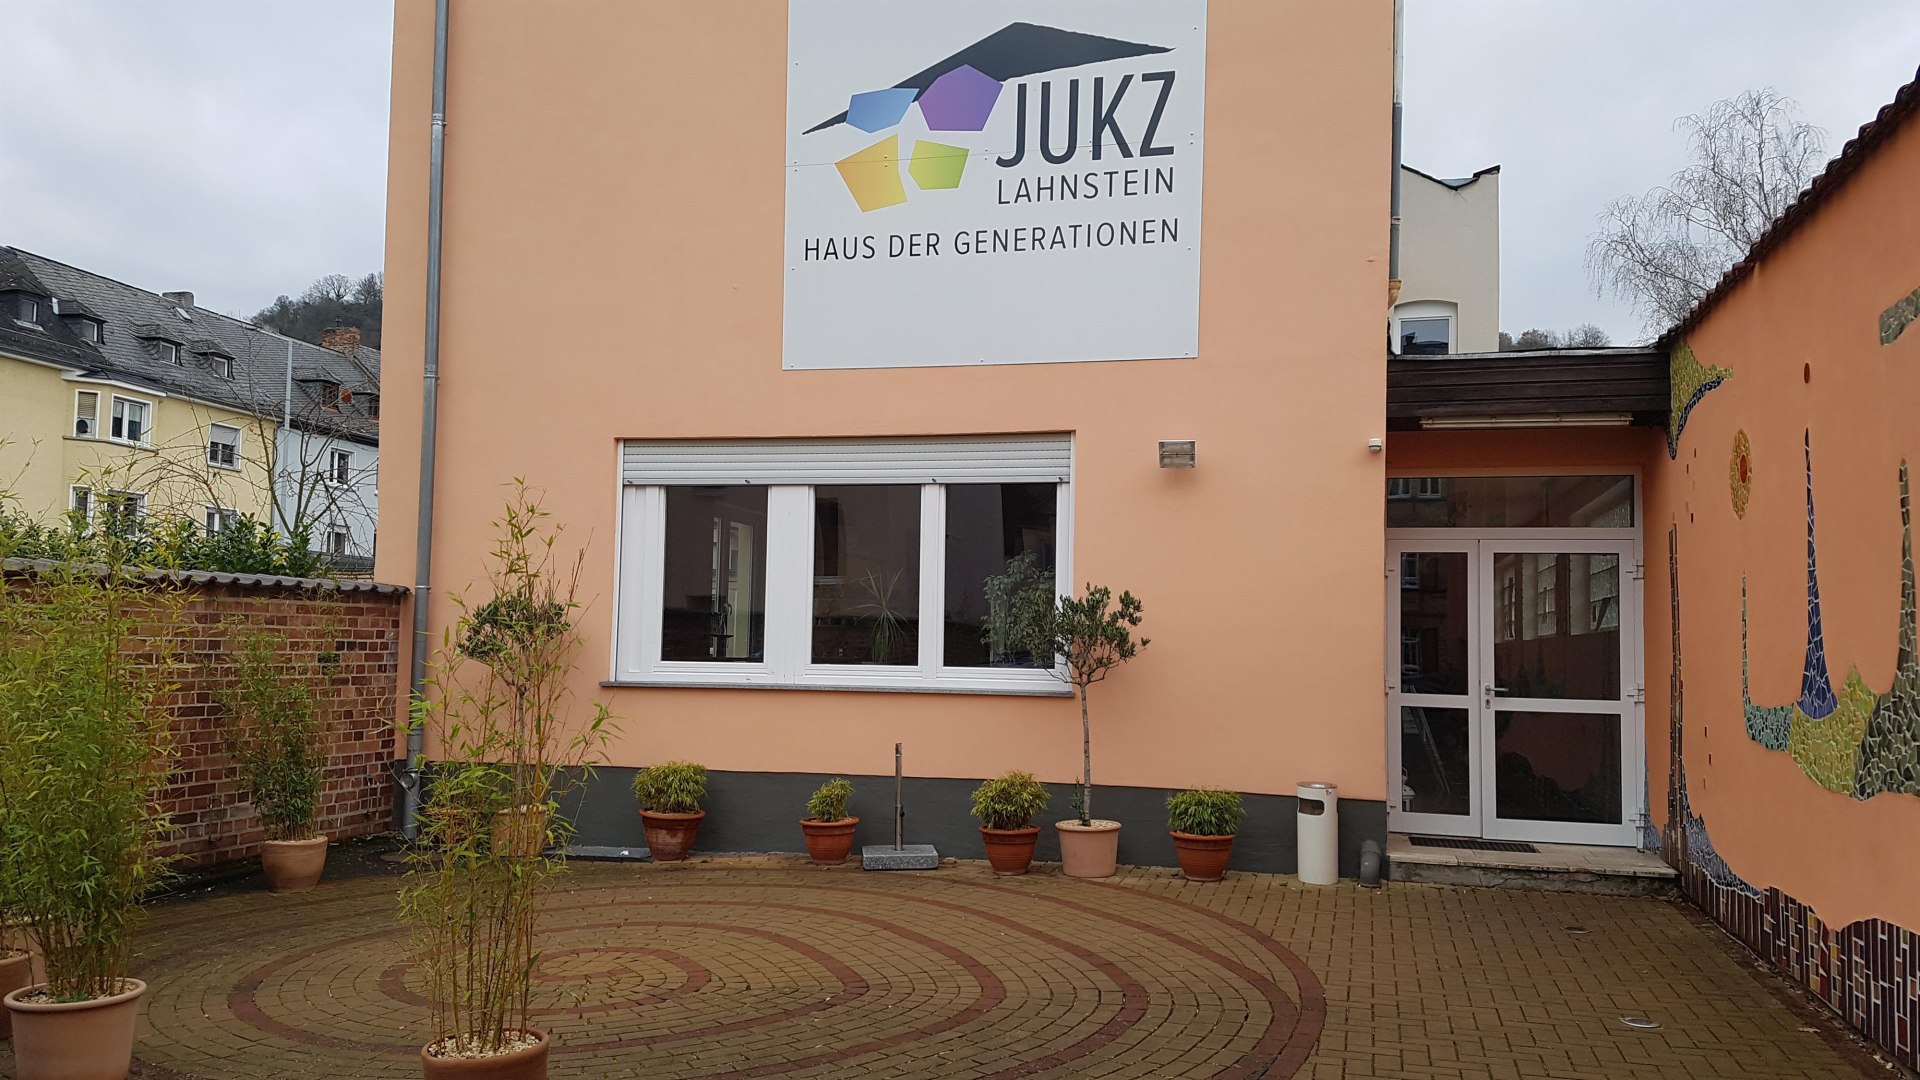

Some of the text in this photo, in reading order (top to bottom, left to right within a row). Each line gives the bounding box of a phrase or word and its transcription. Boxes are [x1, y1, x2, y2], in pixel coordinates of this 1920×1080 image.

[995, 70, 1176, 168] JUKZ
[998, 166, 1174, 205] LAHNSTEIN
[804, 217, 1178, 261] HAUS DER GENERATIONEN
